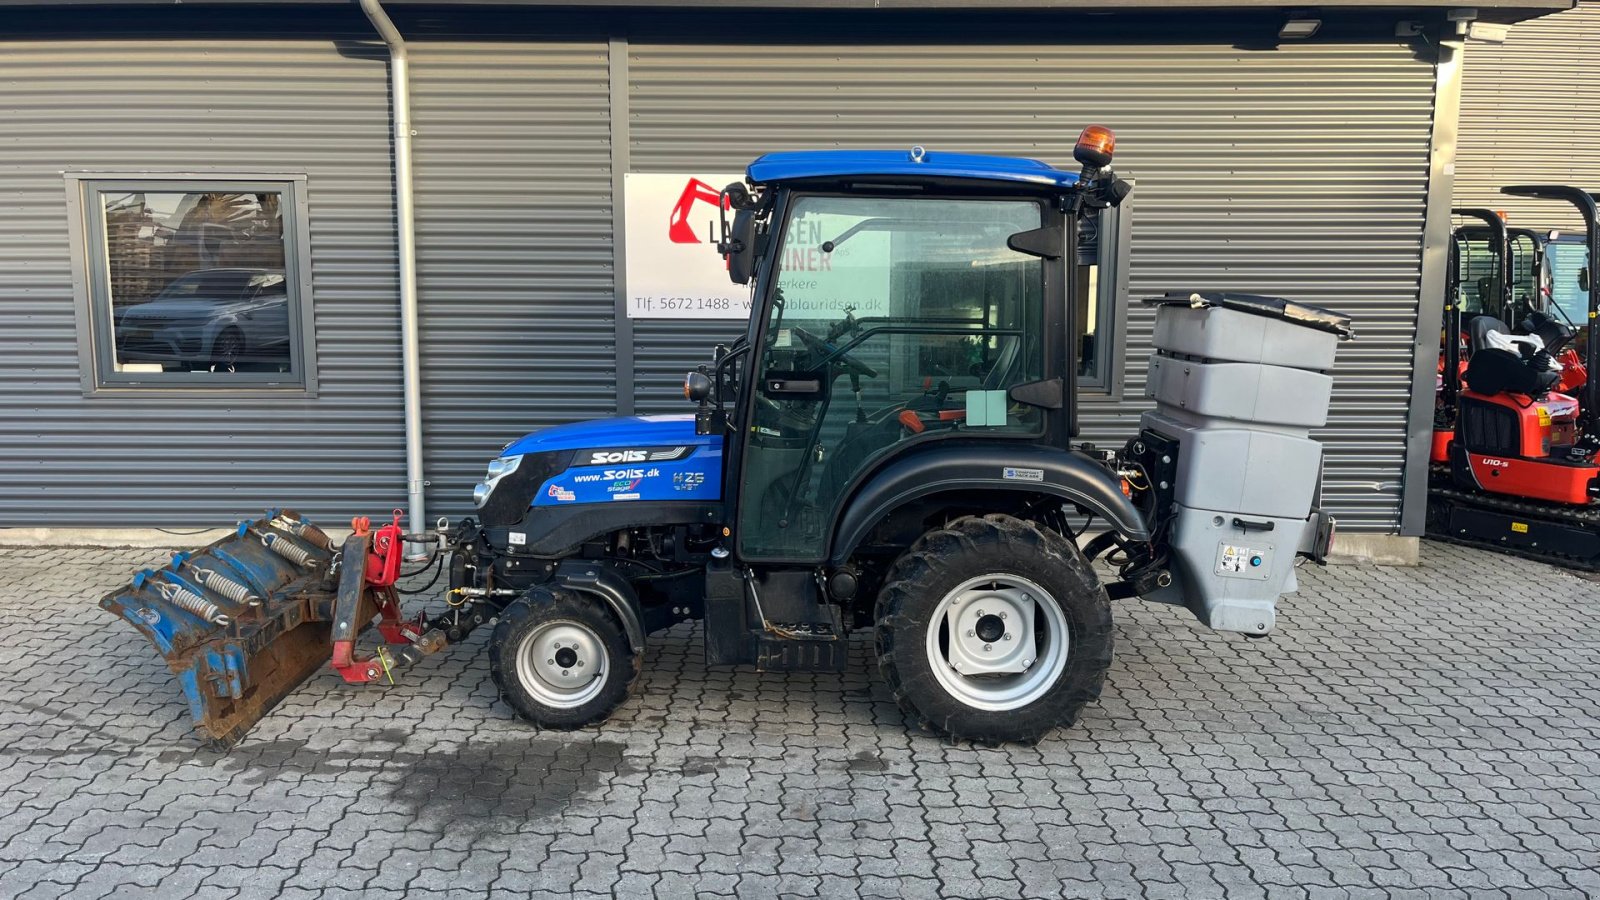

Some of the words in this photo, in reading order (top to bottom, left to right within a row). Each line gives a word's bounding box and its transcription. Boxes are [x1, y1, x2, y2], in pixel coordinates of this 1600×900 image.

[709, 219, 822, 244] LASEN
[726, 247, 832, 272] INER
[635, 296, 656, 312] Tlf.
[660, 297, 693, 310] 5672
[697, 297, 730, 310] 1488
[742, 298, 882, 311] wablauridsen.dk
